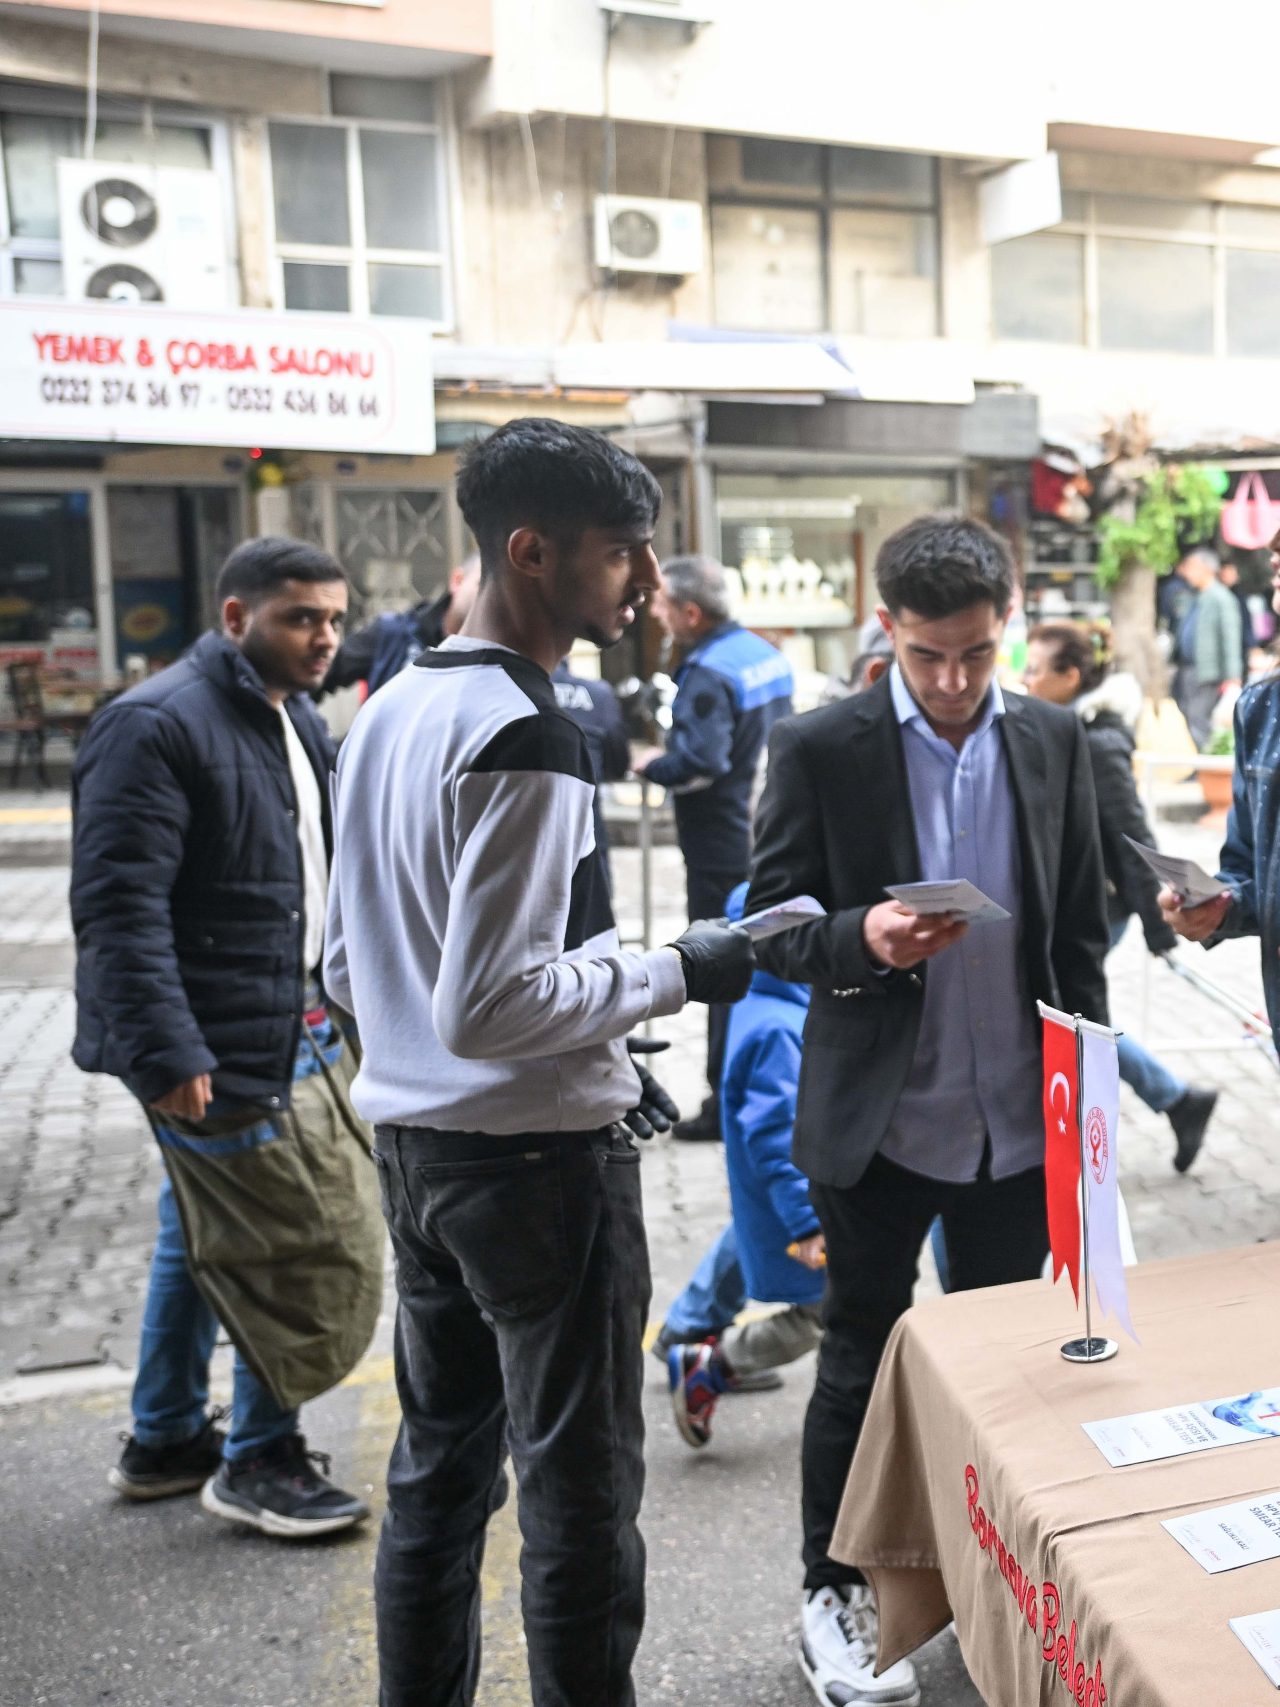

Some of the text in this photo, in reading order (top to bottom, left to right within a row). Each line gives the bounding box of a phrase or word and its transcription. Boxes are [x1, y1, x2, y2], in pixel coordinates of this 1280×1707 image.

[33, 331, 374, 379] YEMEK & ÇORBA SALONU
[41, 376, 90, 405] 0232
[1250, 1507, 1276, 1528] SMEAR
[965, 1463, 1038, 1634] Bornova
